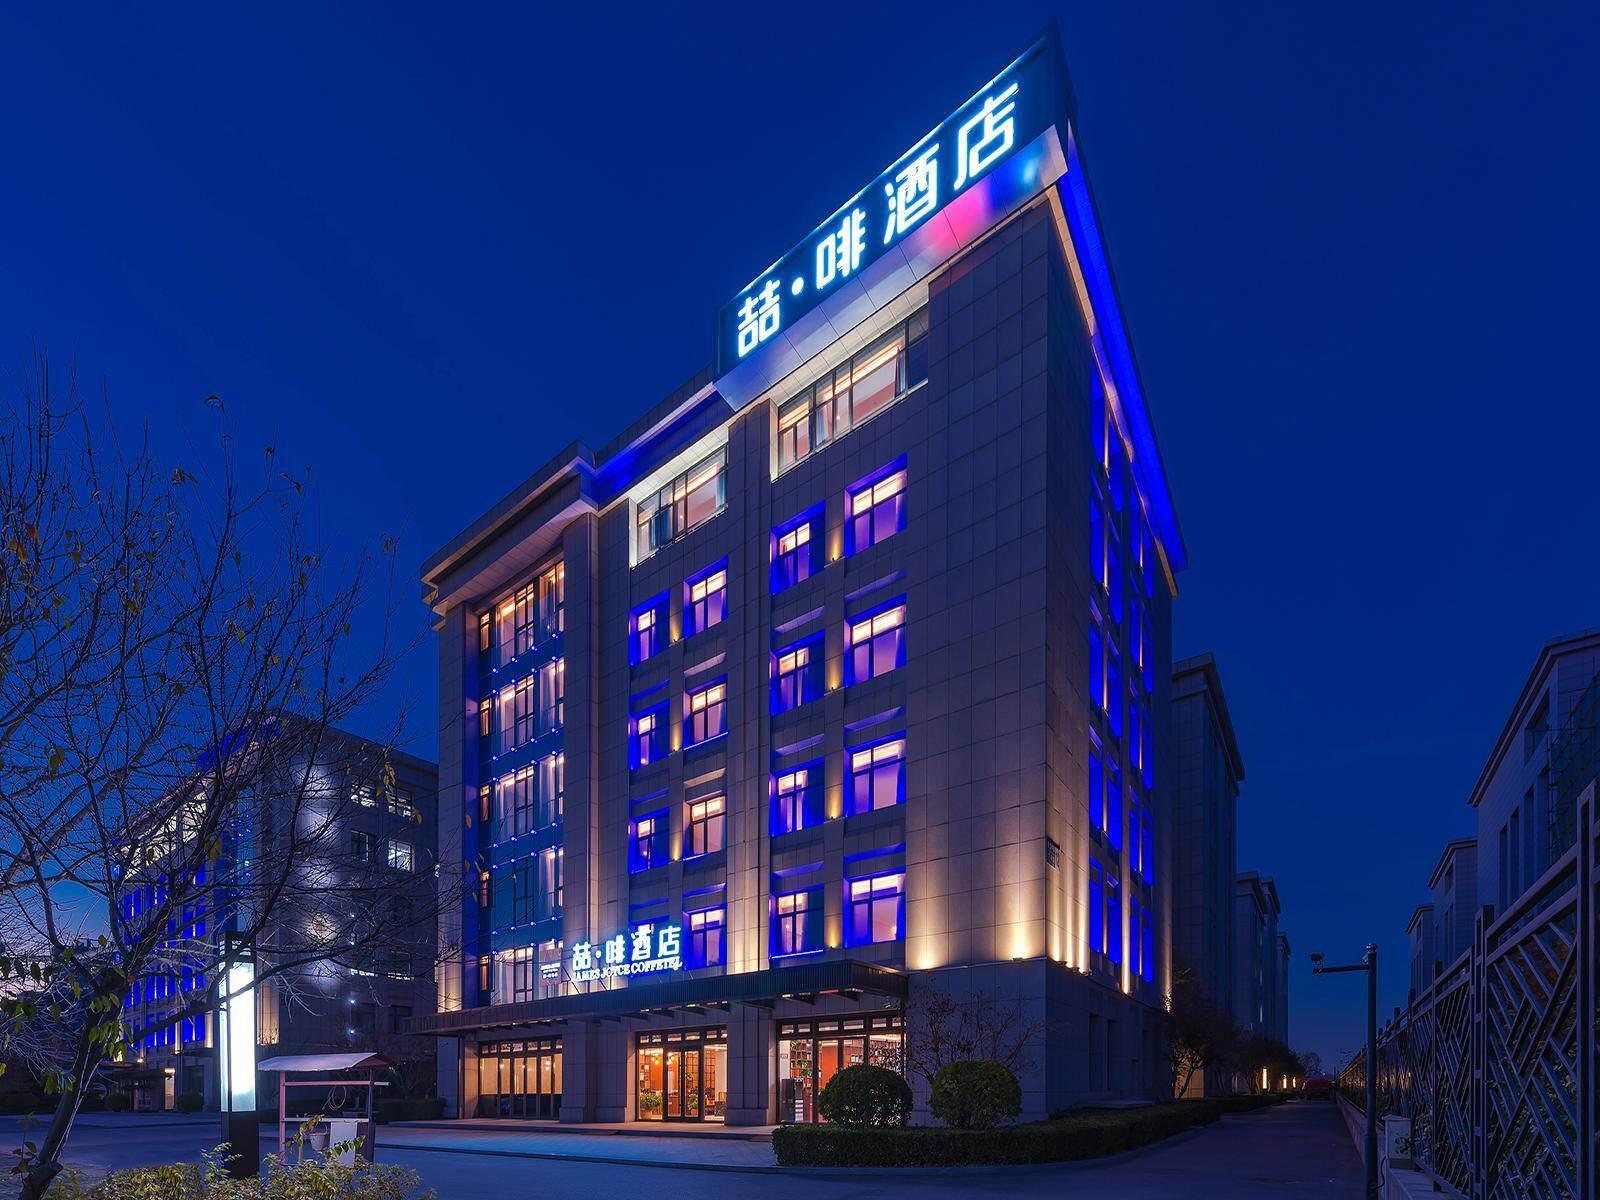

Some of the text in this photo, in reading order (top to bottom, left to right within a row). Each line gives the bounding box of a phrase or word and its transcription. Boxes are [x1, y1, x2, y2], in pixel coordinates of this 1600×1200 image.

[737, 82, 1018, 358] 喆·啡酒店
[572, 925, 682, 971] 喆·啡酒店
[572, 968, 600, 982] JAMES
[601, 963, 630, 978] JOYCE
